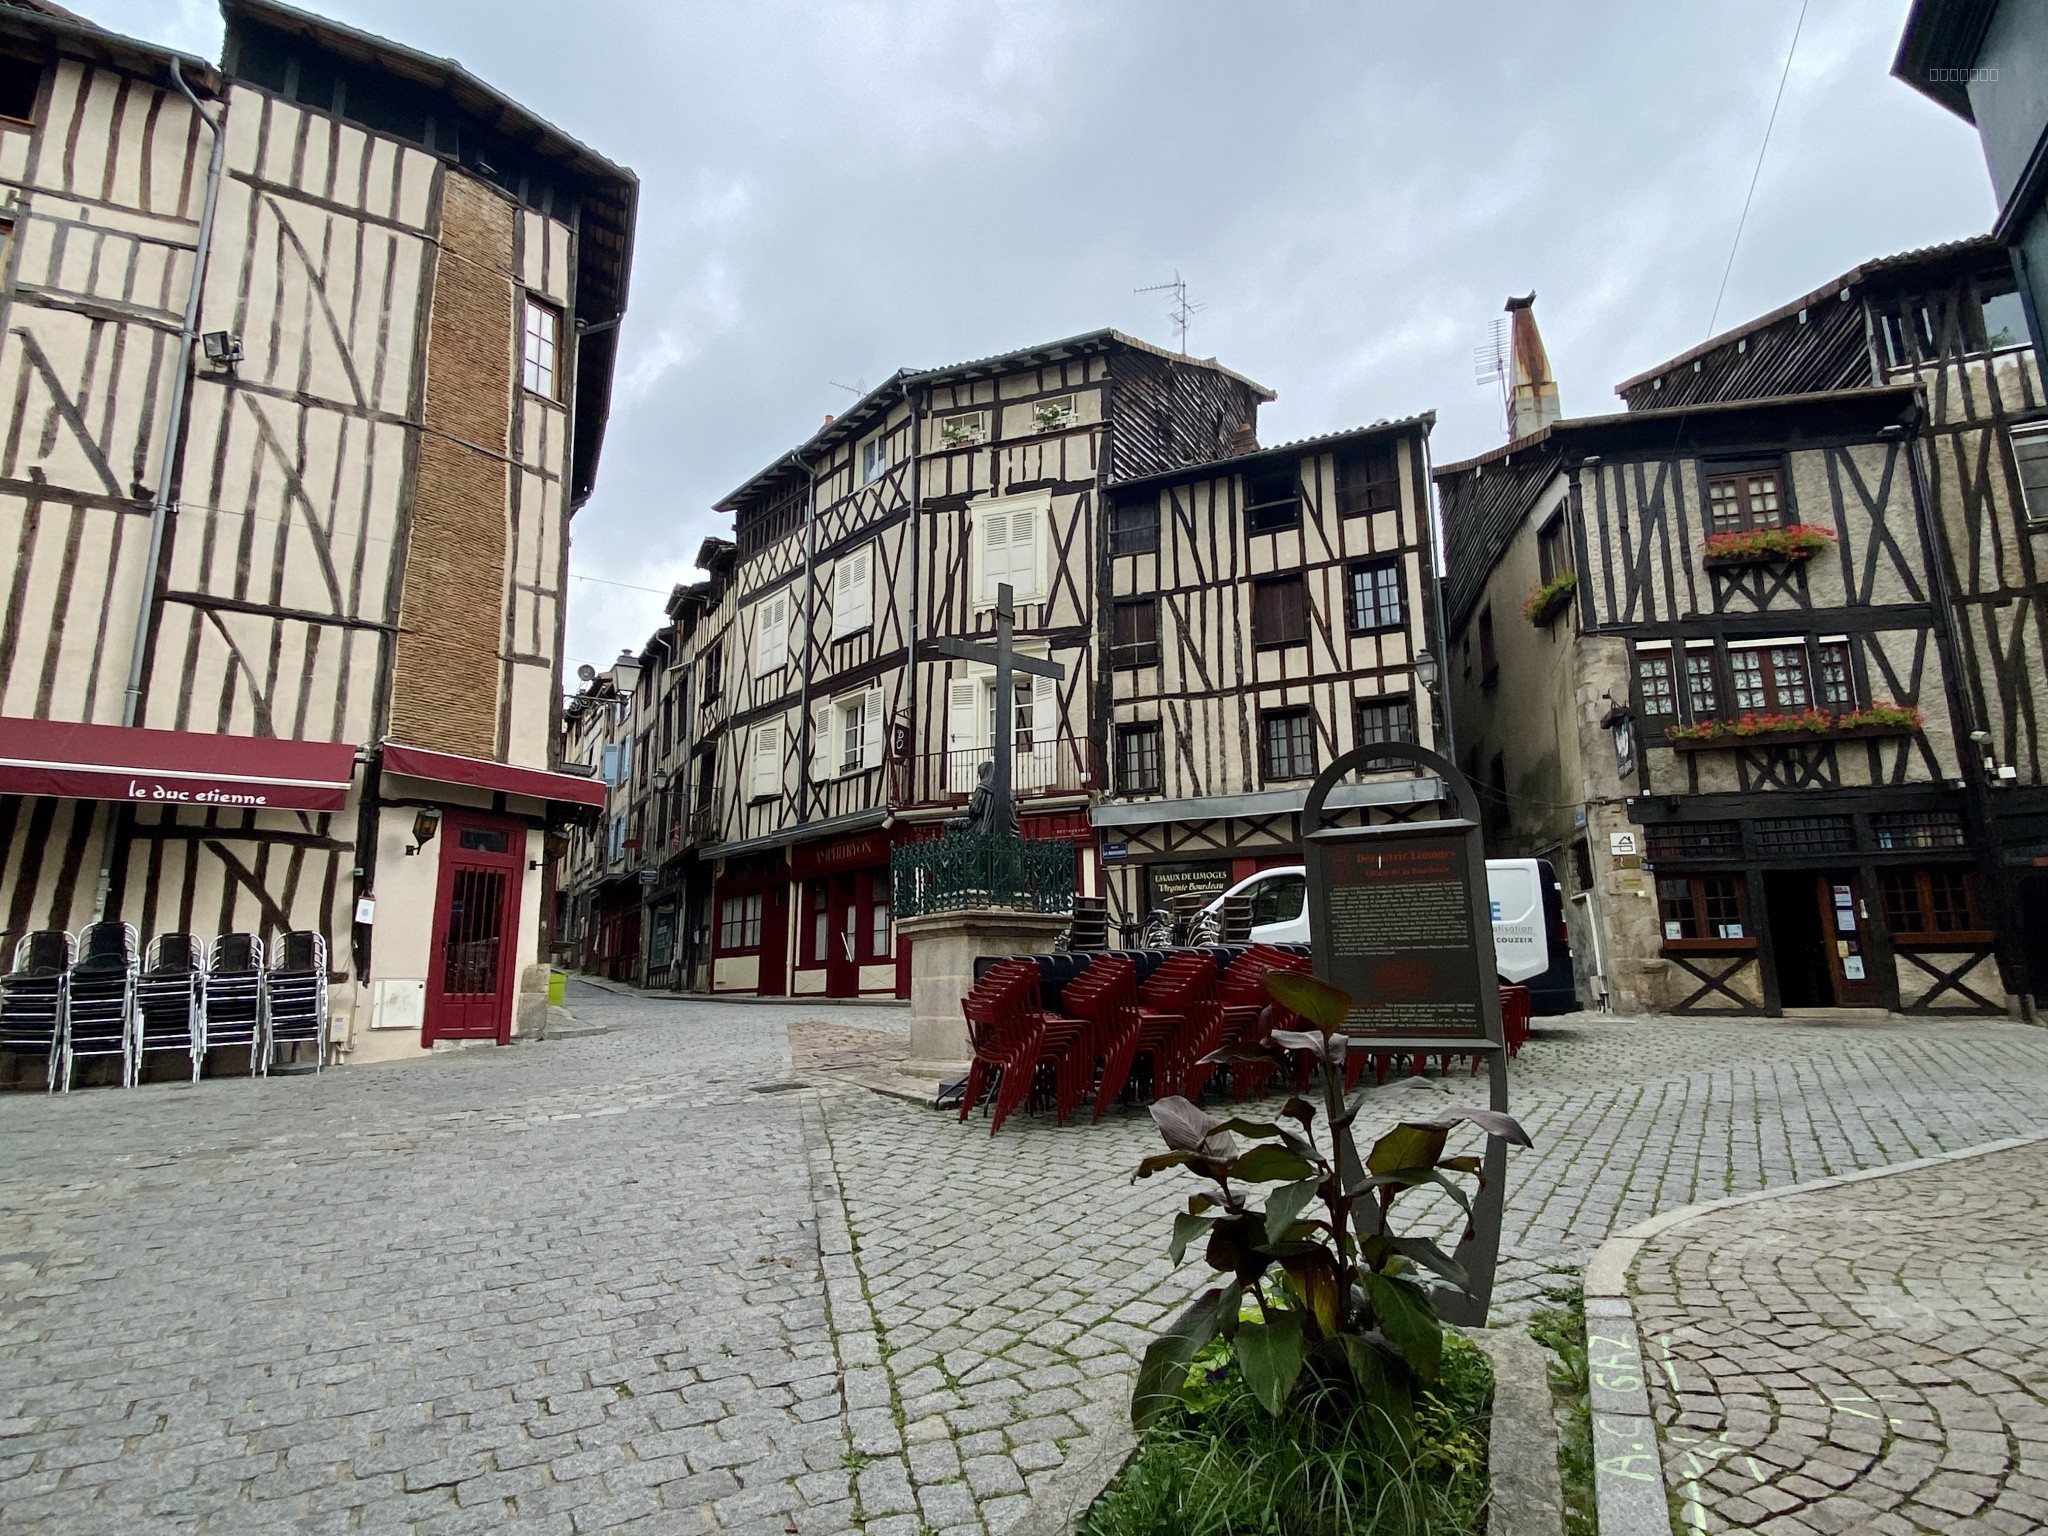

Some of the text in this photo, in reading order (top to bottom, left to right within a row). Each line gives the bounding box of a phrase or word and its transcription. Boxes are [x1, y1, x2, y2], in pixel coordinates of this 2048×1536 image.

[128, 779, 267, 805] le duc etienne
[1181, 872, 1192, 881] DE
[1192, 870, 1227, 880] LIMOGES
[1158, 881, 1224, 894] Virginie Bourdeau
